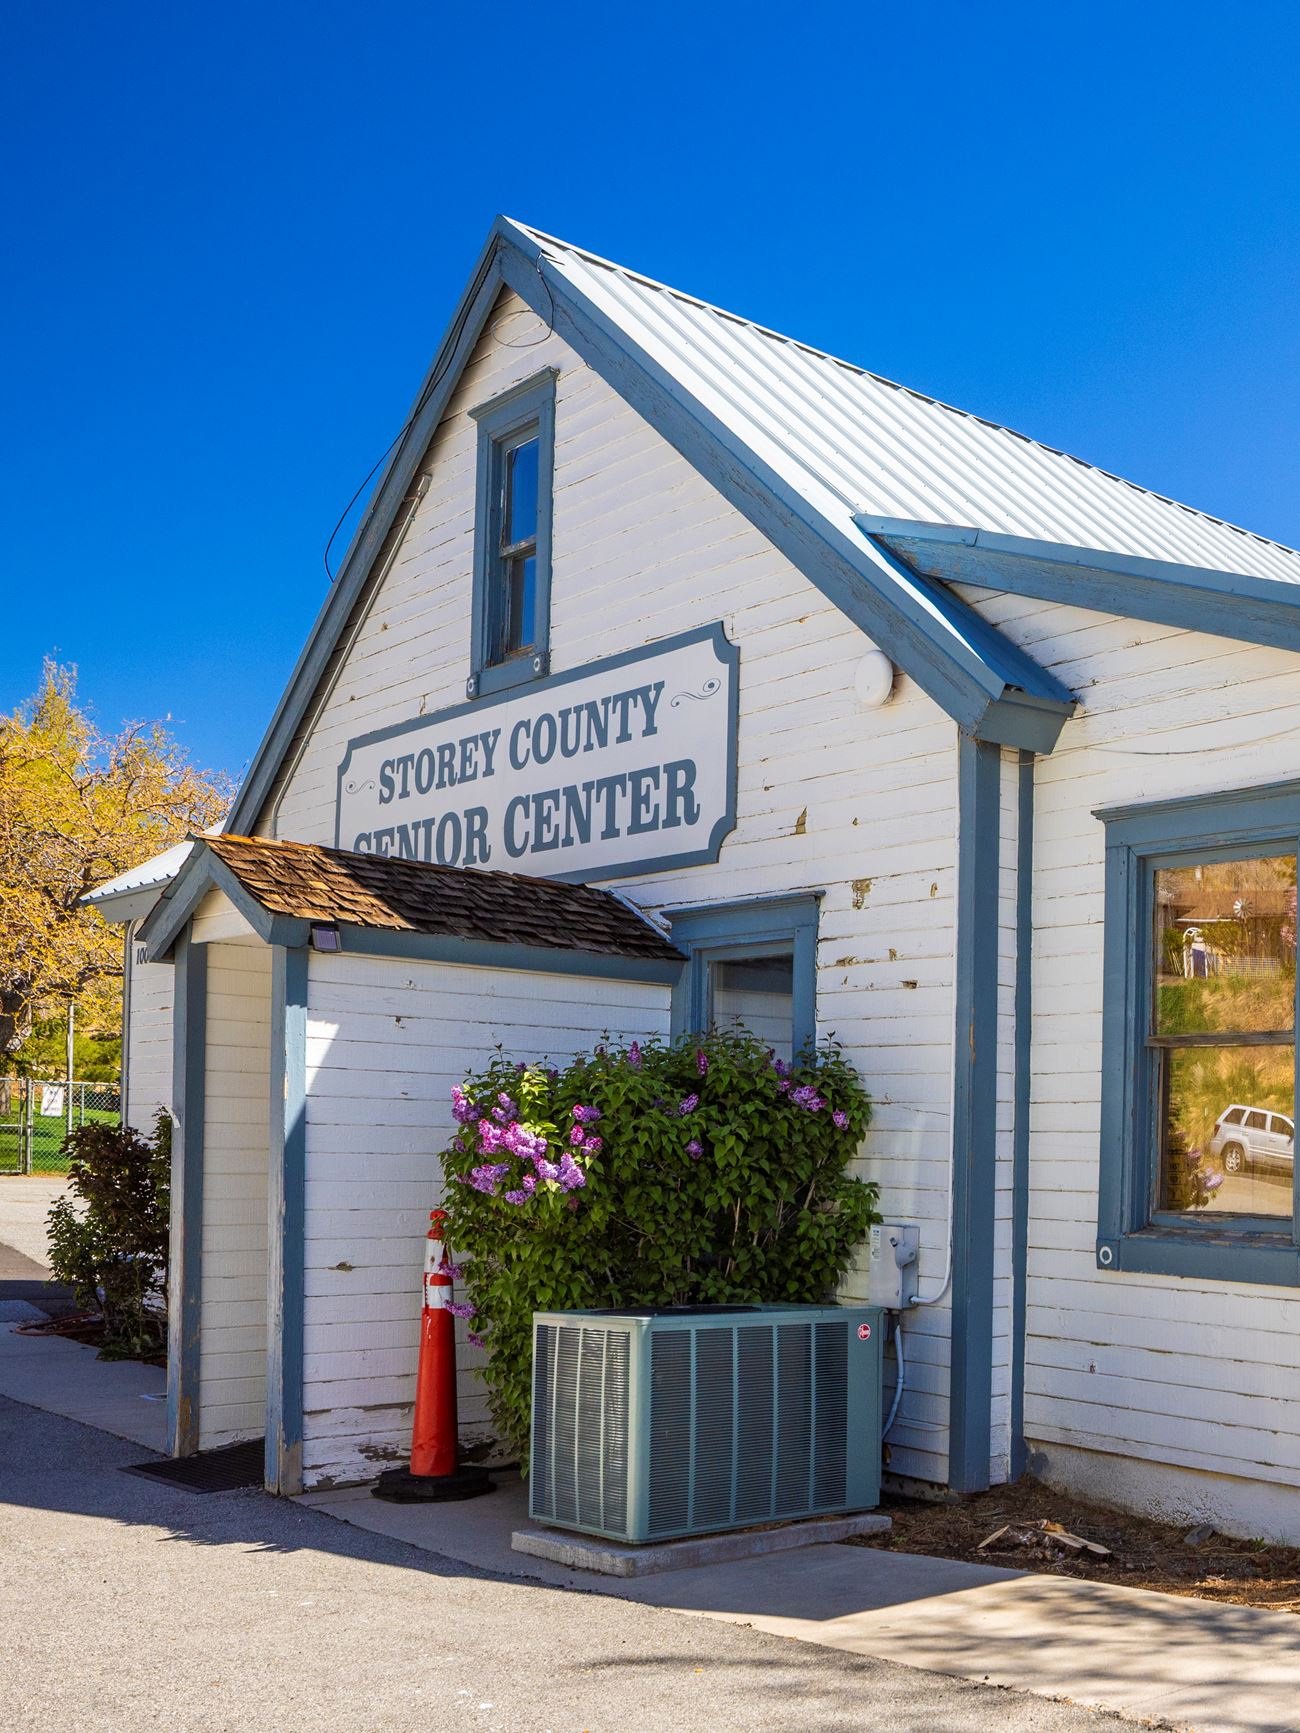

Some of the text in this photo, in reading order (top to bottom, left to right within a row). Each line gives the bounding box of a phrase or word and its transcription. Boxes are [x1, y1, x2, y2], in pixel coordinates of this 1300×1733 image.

[378, 680, 665, 805] STOREY COUNTY
[504, 759, 700, 858] CENTER
